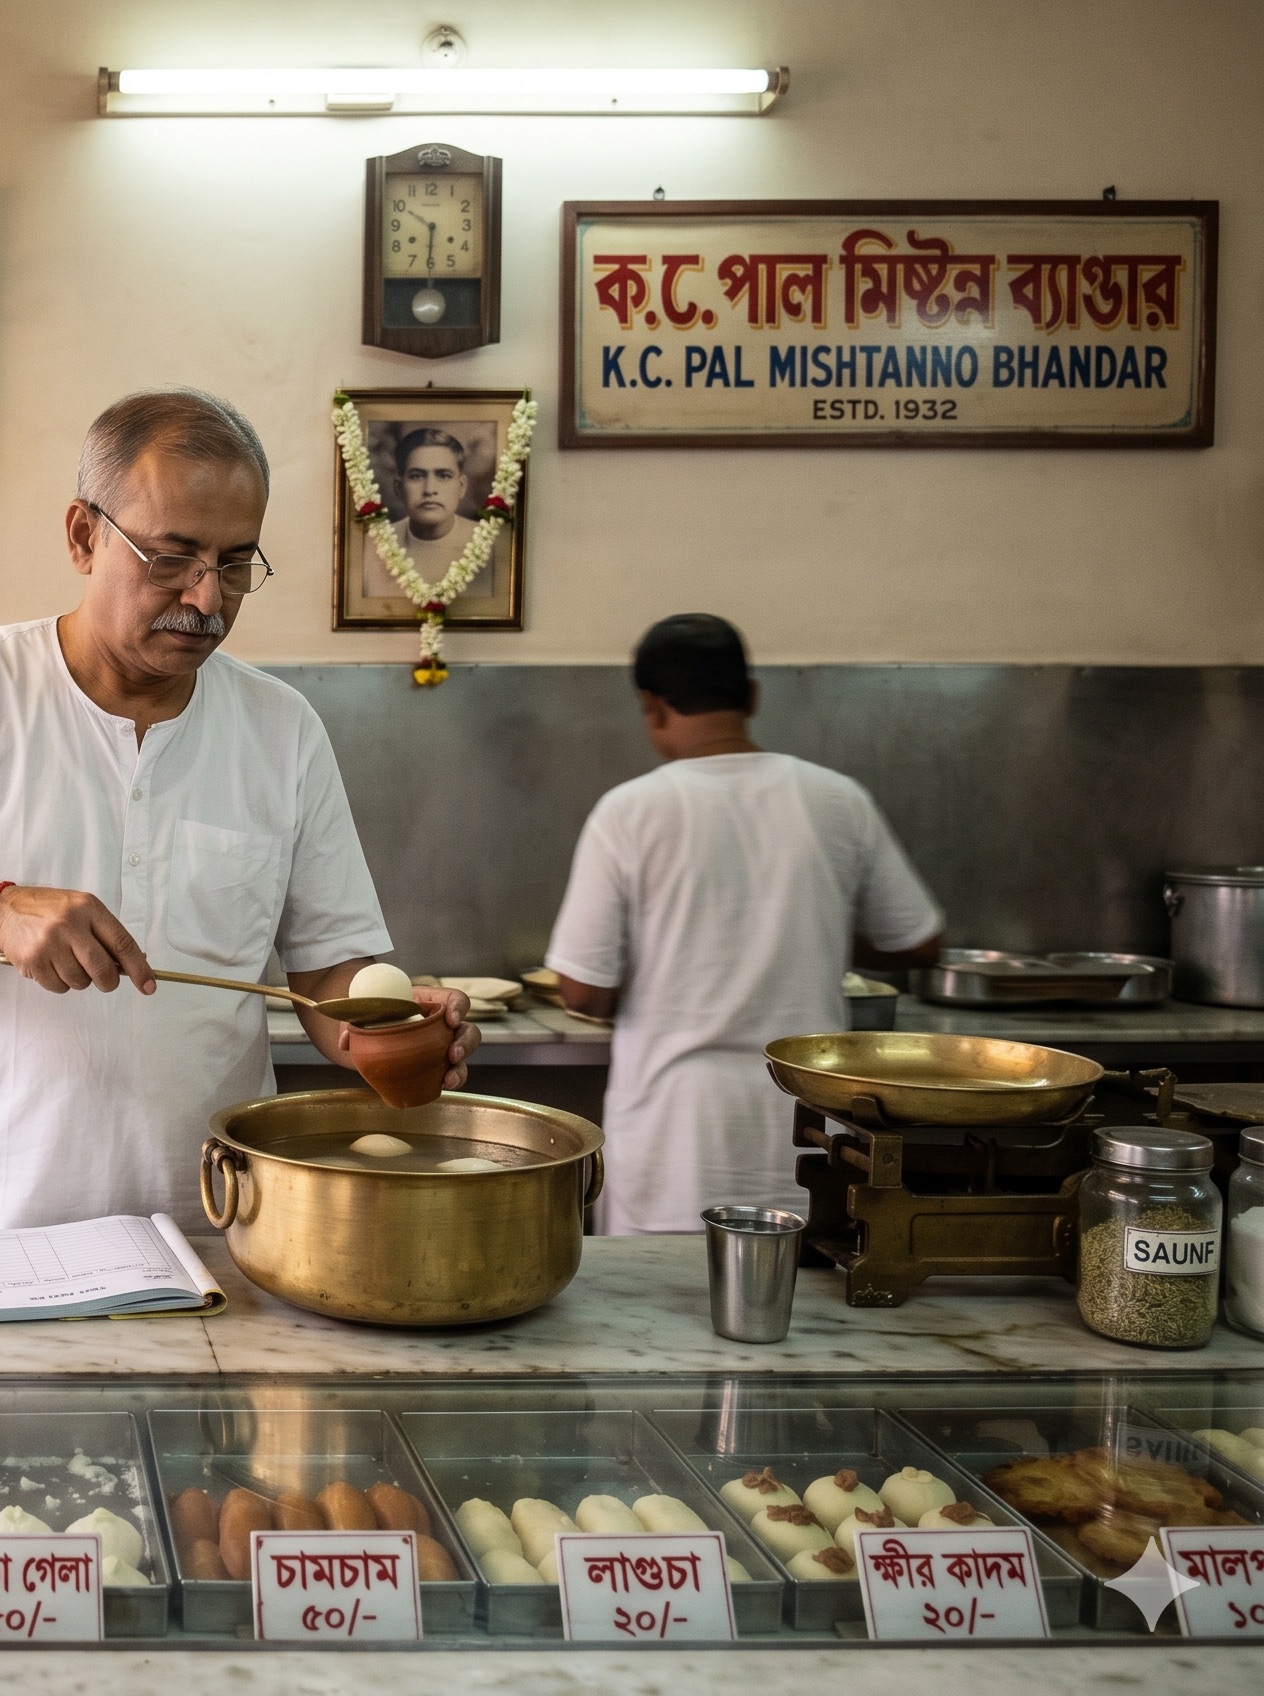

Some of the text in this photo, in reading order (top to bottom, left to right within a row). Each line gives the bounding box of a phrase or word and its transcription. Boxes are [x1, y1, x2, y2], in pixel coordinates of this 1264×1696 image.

[425, 183, 437, 196] 12
[392, 200, 406, 212] 10
[461, 200, 470, 213] 2
[391, 219, 401, 231] 9
[462, 219, 471, 231] 3
[392, 240, 401, 252] 8
[461, 240, 469, 252] 4
[408, 255, 417, 267] 7
[447, 255, 456, 267] 5
[602, 346, 1167, 389] K.C. PAL MISHTANNO BHANDAR
[813, 400, 958, 421] ESTD. 1932
[1134, 1239, 1215, 1264] SAUNF
[23, 1552, 93, 1593] গেলা
[271, 1550, 401, 1590] চামচাম
[614, 1601, 688, 1638] ২০/-
[923, 1597, 995, 1635] ২০/-
